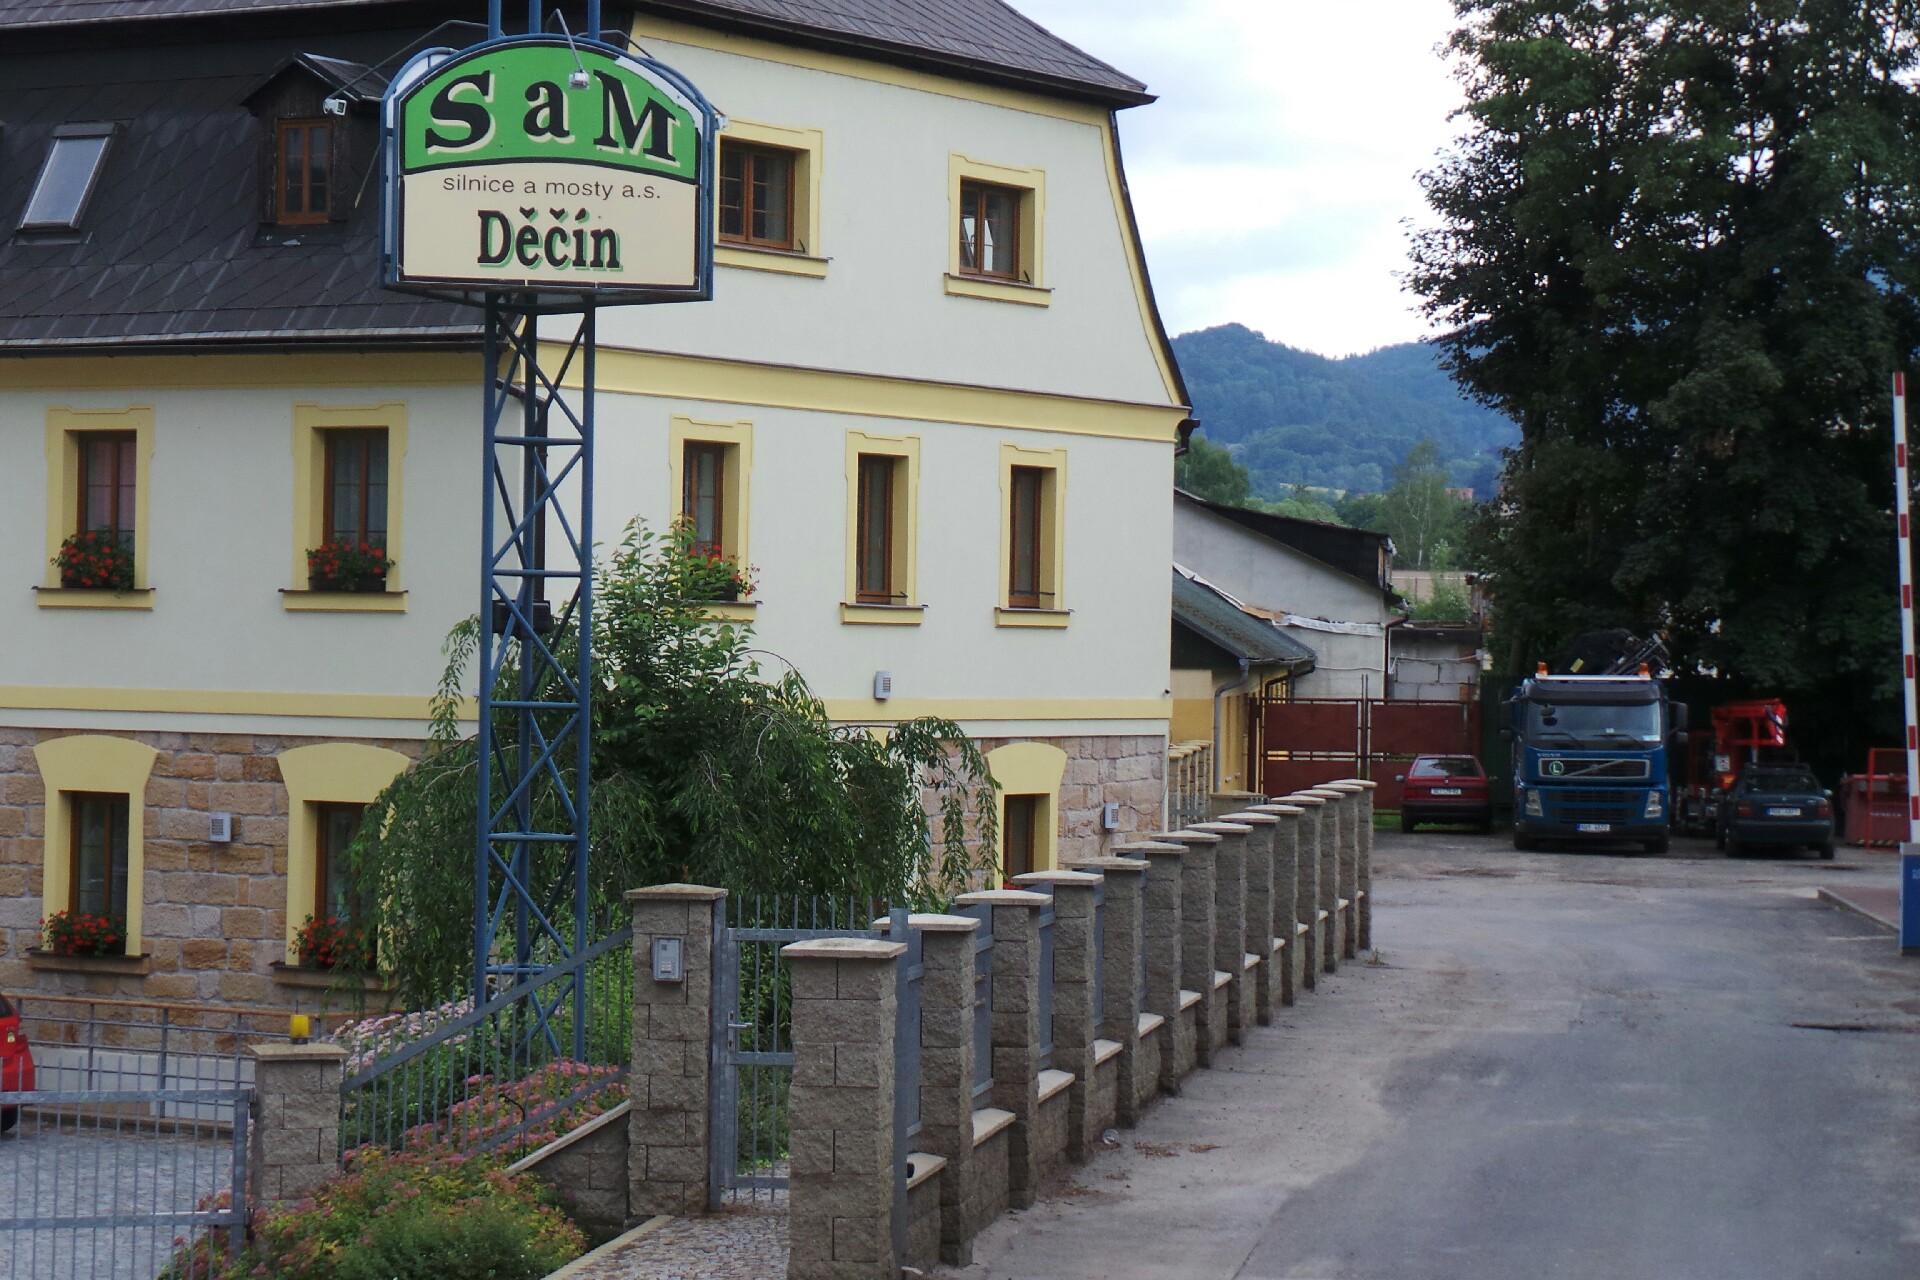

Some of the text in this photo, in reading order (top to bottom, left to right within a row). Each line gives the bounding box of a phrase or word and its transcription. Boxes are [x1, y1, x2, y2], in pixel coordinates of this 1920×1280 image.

[425, 69, 681, 168] S a M
[443, 174, 661, 201] silnice a mosty a.s.
[477, 206, 623, 272] Děčín
